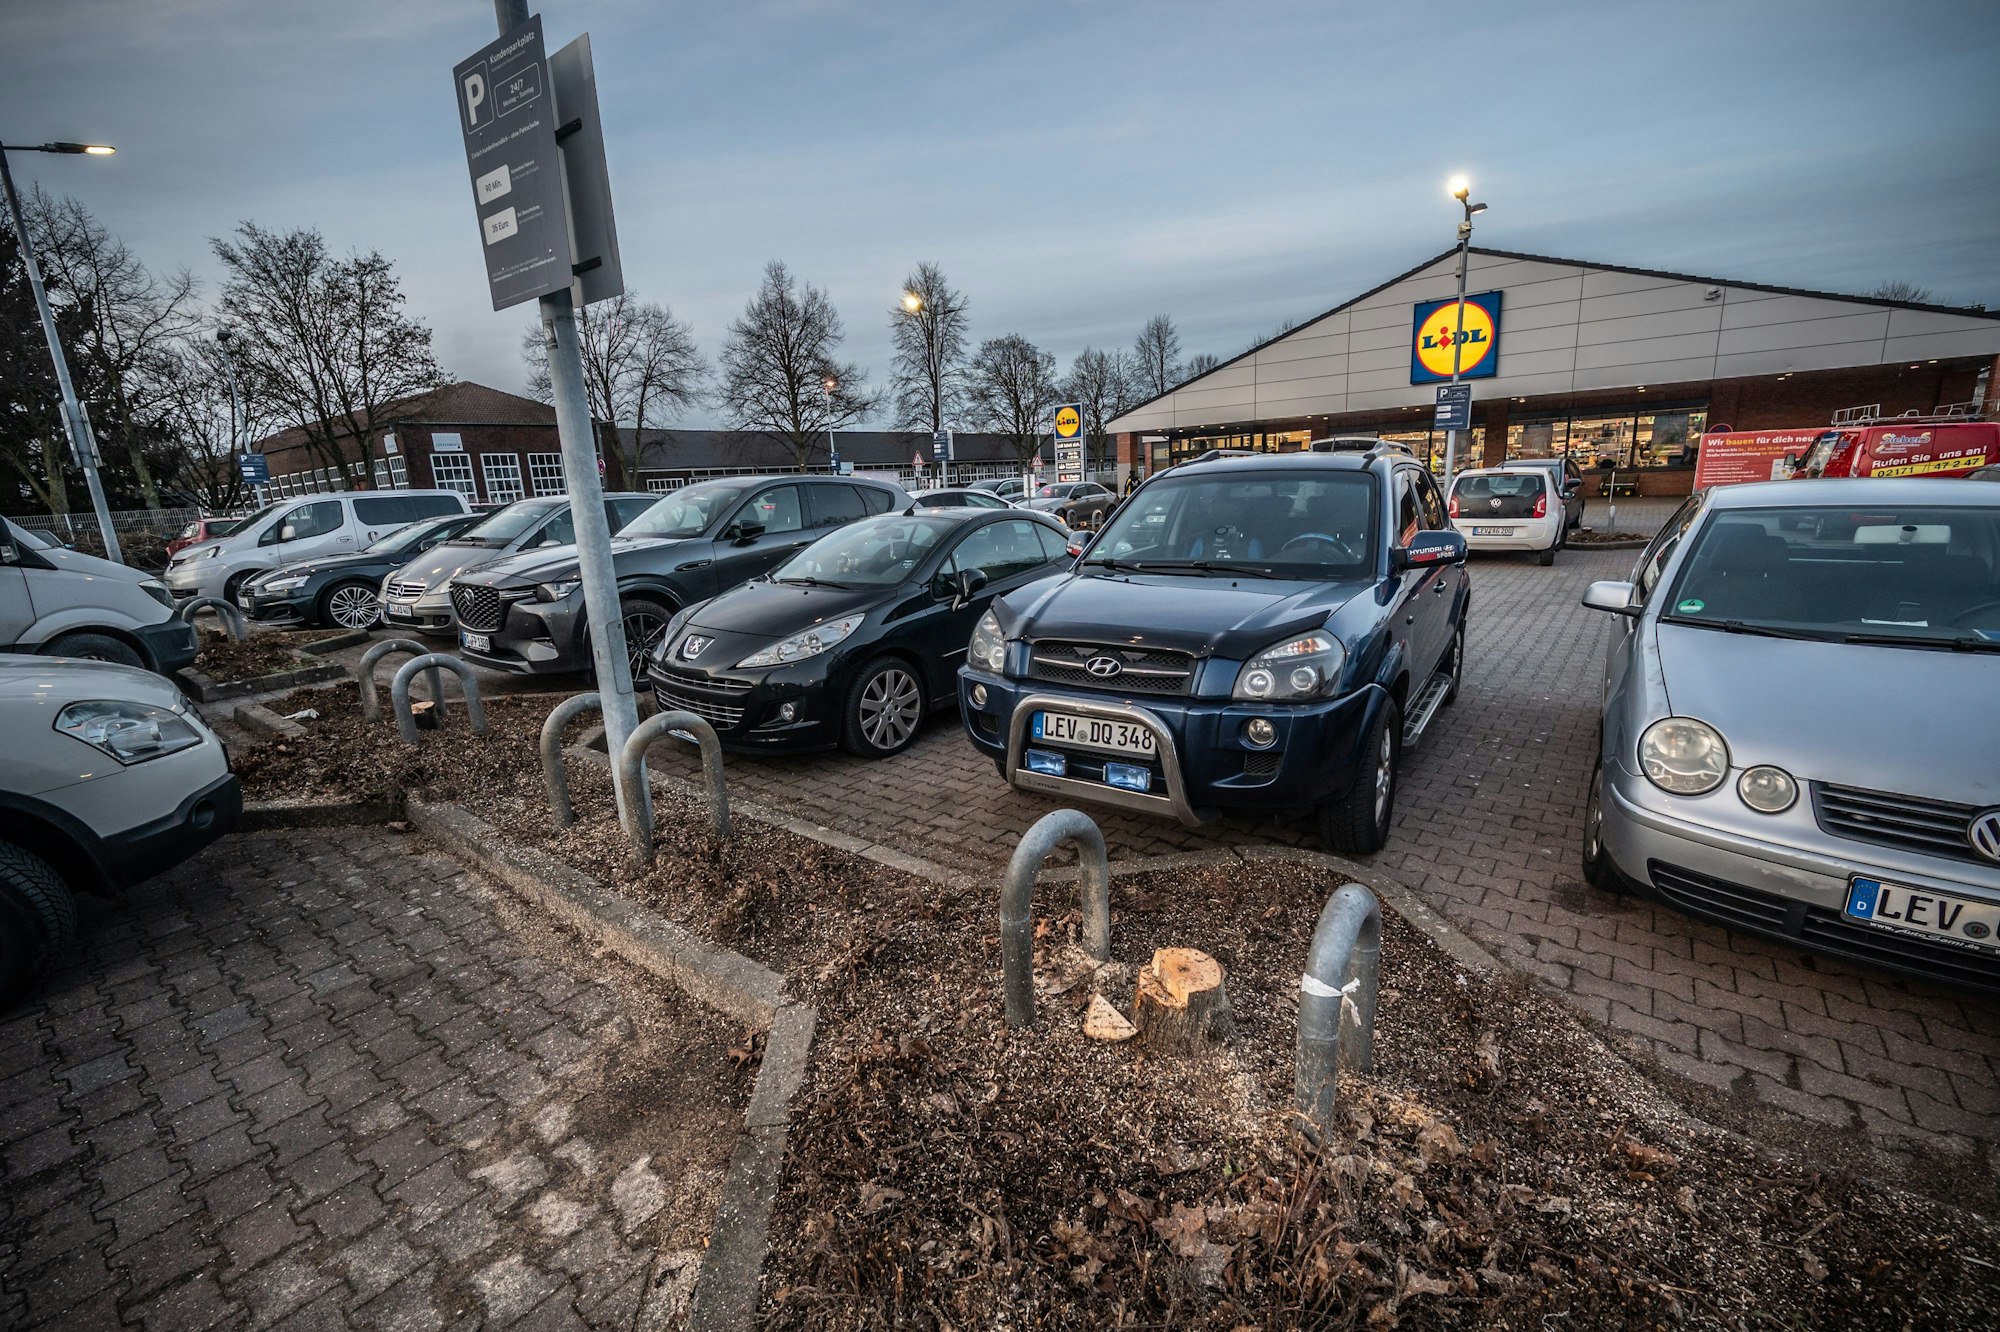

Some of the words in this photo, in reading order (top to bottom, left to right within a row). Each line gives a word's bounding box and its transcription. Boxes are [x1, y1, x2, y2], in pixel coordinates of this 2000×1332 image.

[489, 31, 535, 65] Kundenparkplatz
[509, 78, 524, 95] 24/7
[464, 73, 485, 125] P
[485, 183, 492, 193] 90
[492, 180, 503, 190] Min.
[491, 223, 498, 233] 35
[498, 221, 509, 231] Euro
[1708, 438, 1724, 446] Wir
[1772, 435, 1793, 443] dich
[1872, 458, 1907, 469] Rufen
[1910, 454, 1930, 463] Sie
[1939, 450, 1962, 459] uns
[1877, 466, 1914, 478] 02171
[1934, 462, 1949, 470] 47
[1953, 460, 1960, 468] 2
[1964, 458, 1980, 466] 47
[1409, 546, 1442, 555] HYUNDAI
[1437, 551, 1455, 559] SPORT
[1045, 715, 1077, 740] LEV
[1090, 722, 1113, 745] DQ
[1118, 725, 1152, 750] 348
[1877, 889, 1963, 931] LEV
